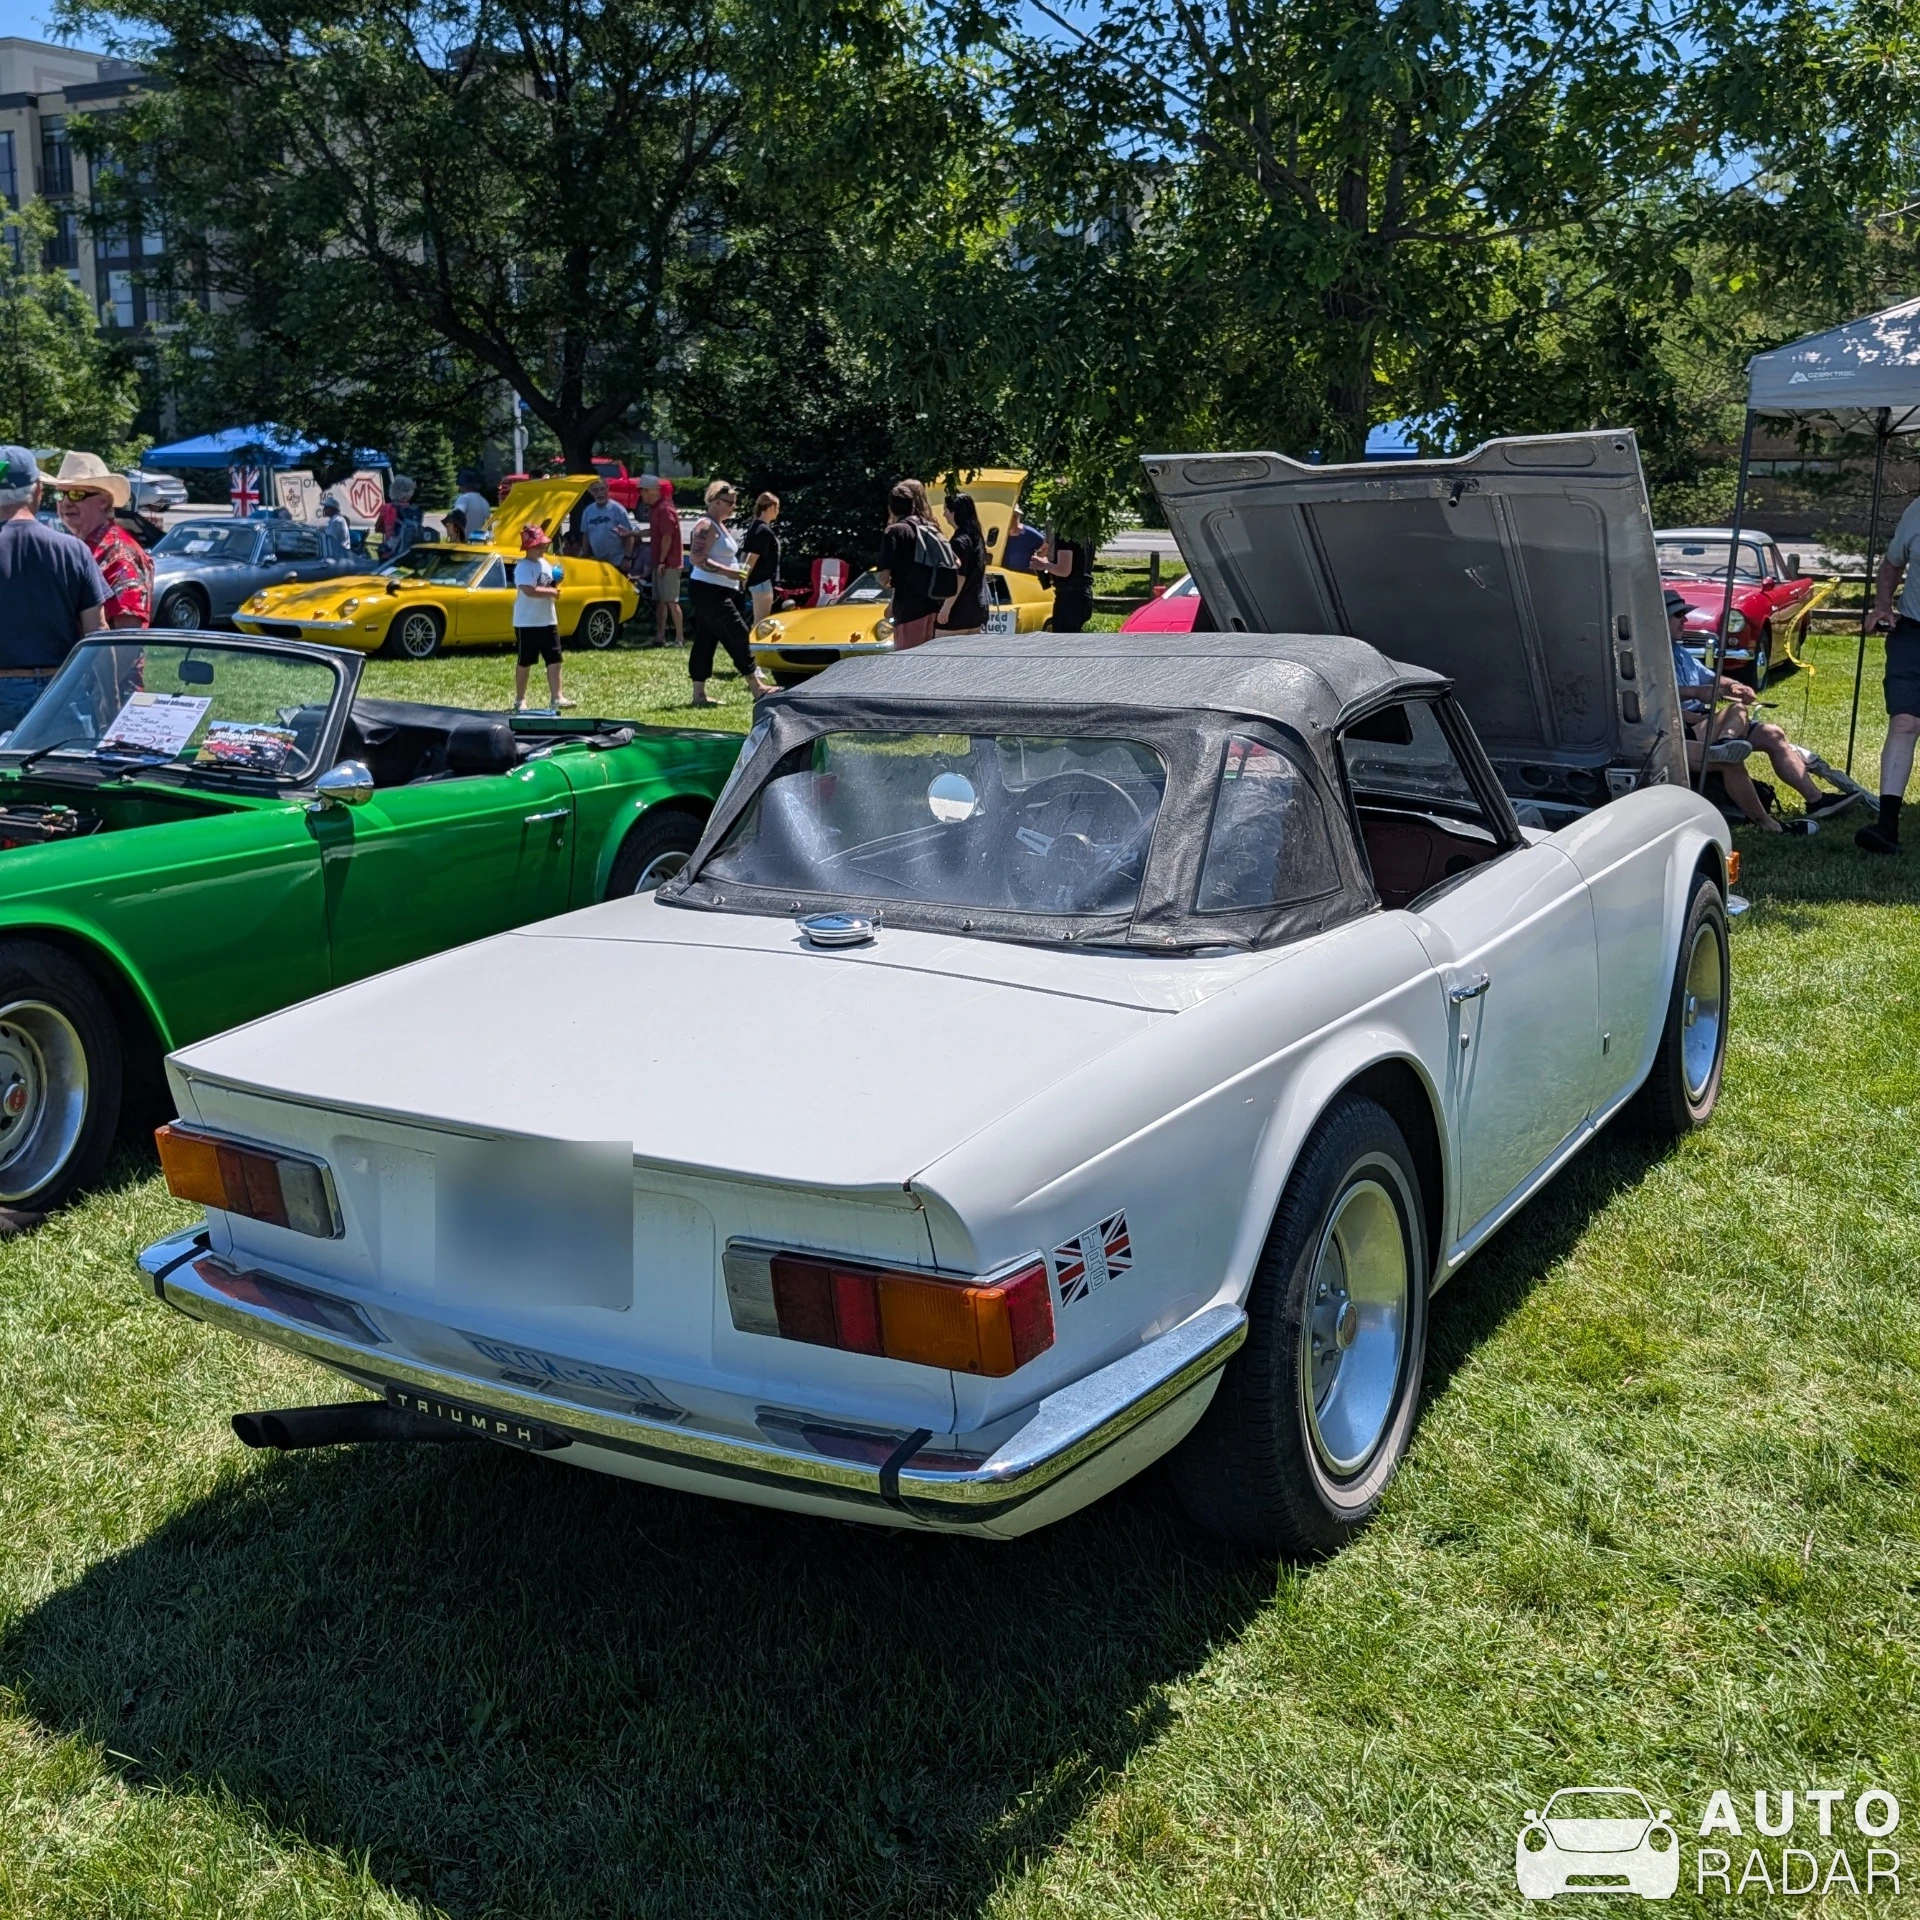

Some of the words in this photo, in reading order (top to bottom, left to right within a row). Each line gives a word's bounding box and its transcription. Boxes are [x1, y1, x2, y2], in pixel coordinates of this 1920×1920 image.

[353, 482, 381, 515] MG
[990, 612, 1008, 622] red
[1082, 1227, 1107, 1291] TR6
[397, 1393, 531, 1442] TRIUMPH
